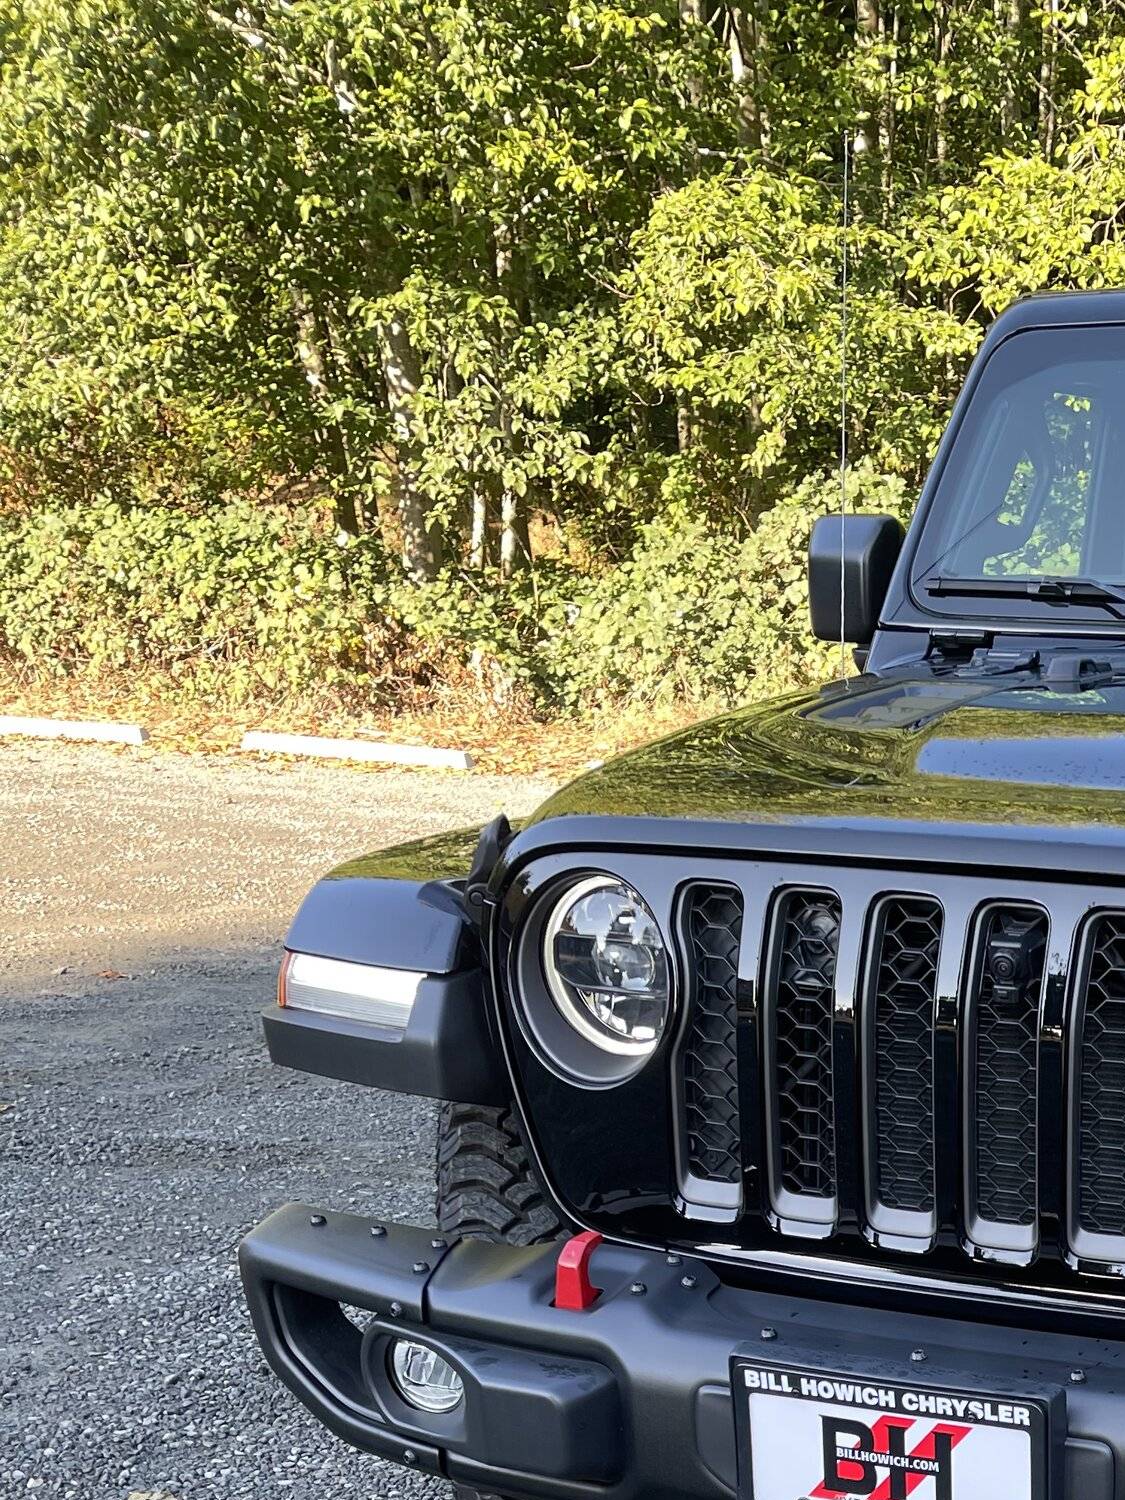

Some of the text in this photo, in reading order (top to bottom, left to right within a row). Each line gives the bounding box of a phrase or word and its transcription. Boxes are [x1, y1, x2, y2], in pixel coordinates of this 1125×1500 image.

[743, 1368, 1031, 1427] BILL HOWICH CHRYSLER
[835, 1445, 941, 1474] BILLHOWICH.COM
